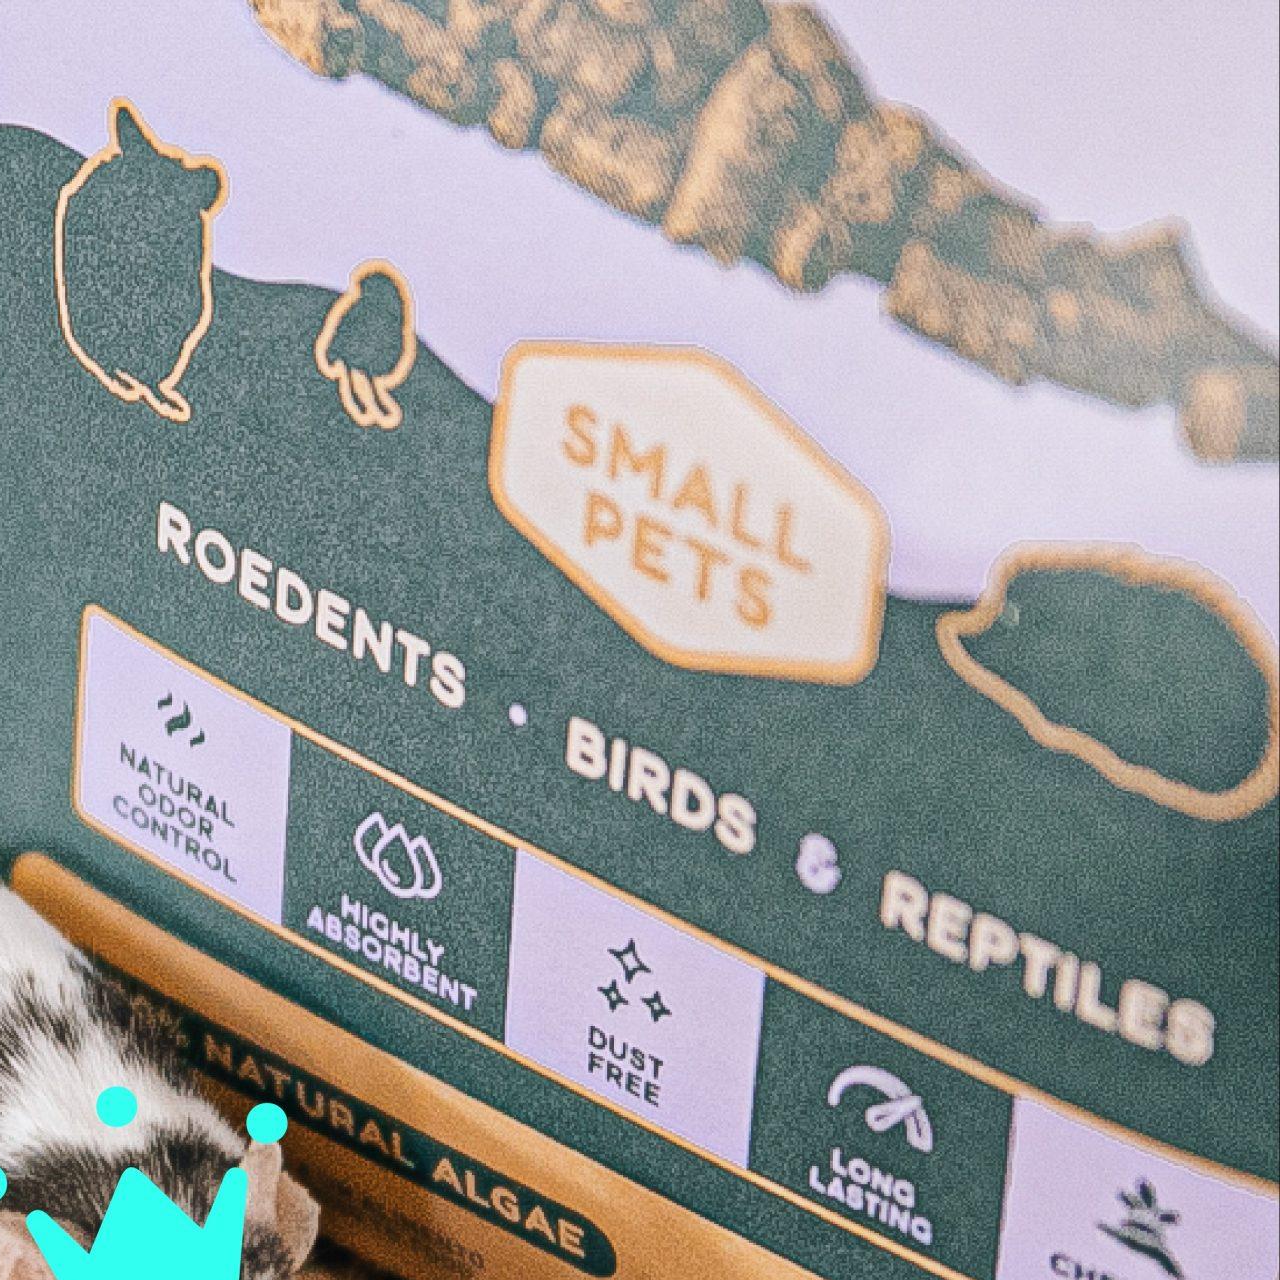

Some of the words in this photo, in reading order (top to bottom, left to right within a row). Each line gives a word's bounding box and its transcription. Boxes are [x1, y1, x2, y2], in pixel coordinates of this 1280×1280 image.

[562, 404, 813, 574] SMALL
[584, 490, 771, 630] PETS
[120, 742, 235, 828] NATURAL
[139, 783, 213, 842] ODOR
[157, 501, 466, 709] ROEDENTS
[565, 716, 757, 854] BIRDS
[796, 833, 841, 894] &
[880, 870, 1215, 1067] REPTILES
[113, 795, 237, 884] CONTROL
[307, 905, 477, 1010] ABSORBENT
[341, 892, 444, 967] HIGHLY
[588, 1026, 663, 1079] DUST
[588, 1052, 660, 1107] FREE
[204, 1034, 415, 1169] NATURAL
[432, 1158, 584, 1259] ALGAE
[831, 1147, 915, 1208] LONG
[809, 1166, 933, 1245] LASTING
